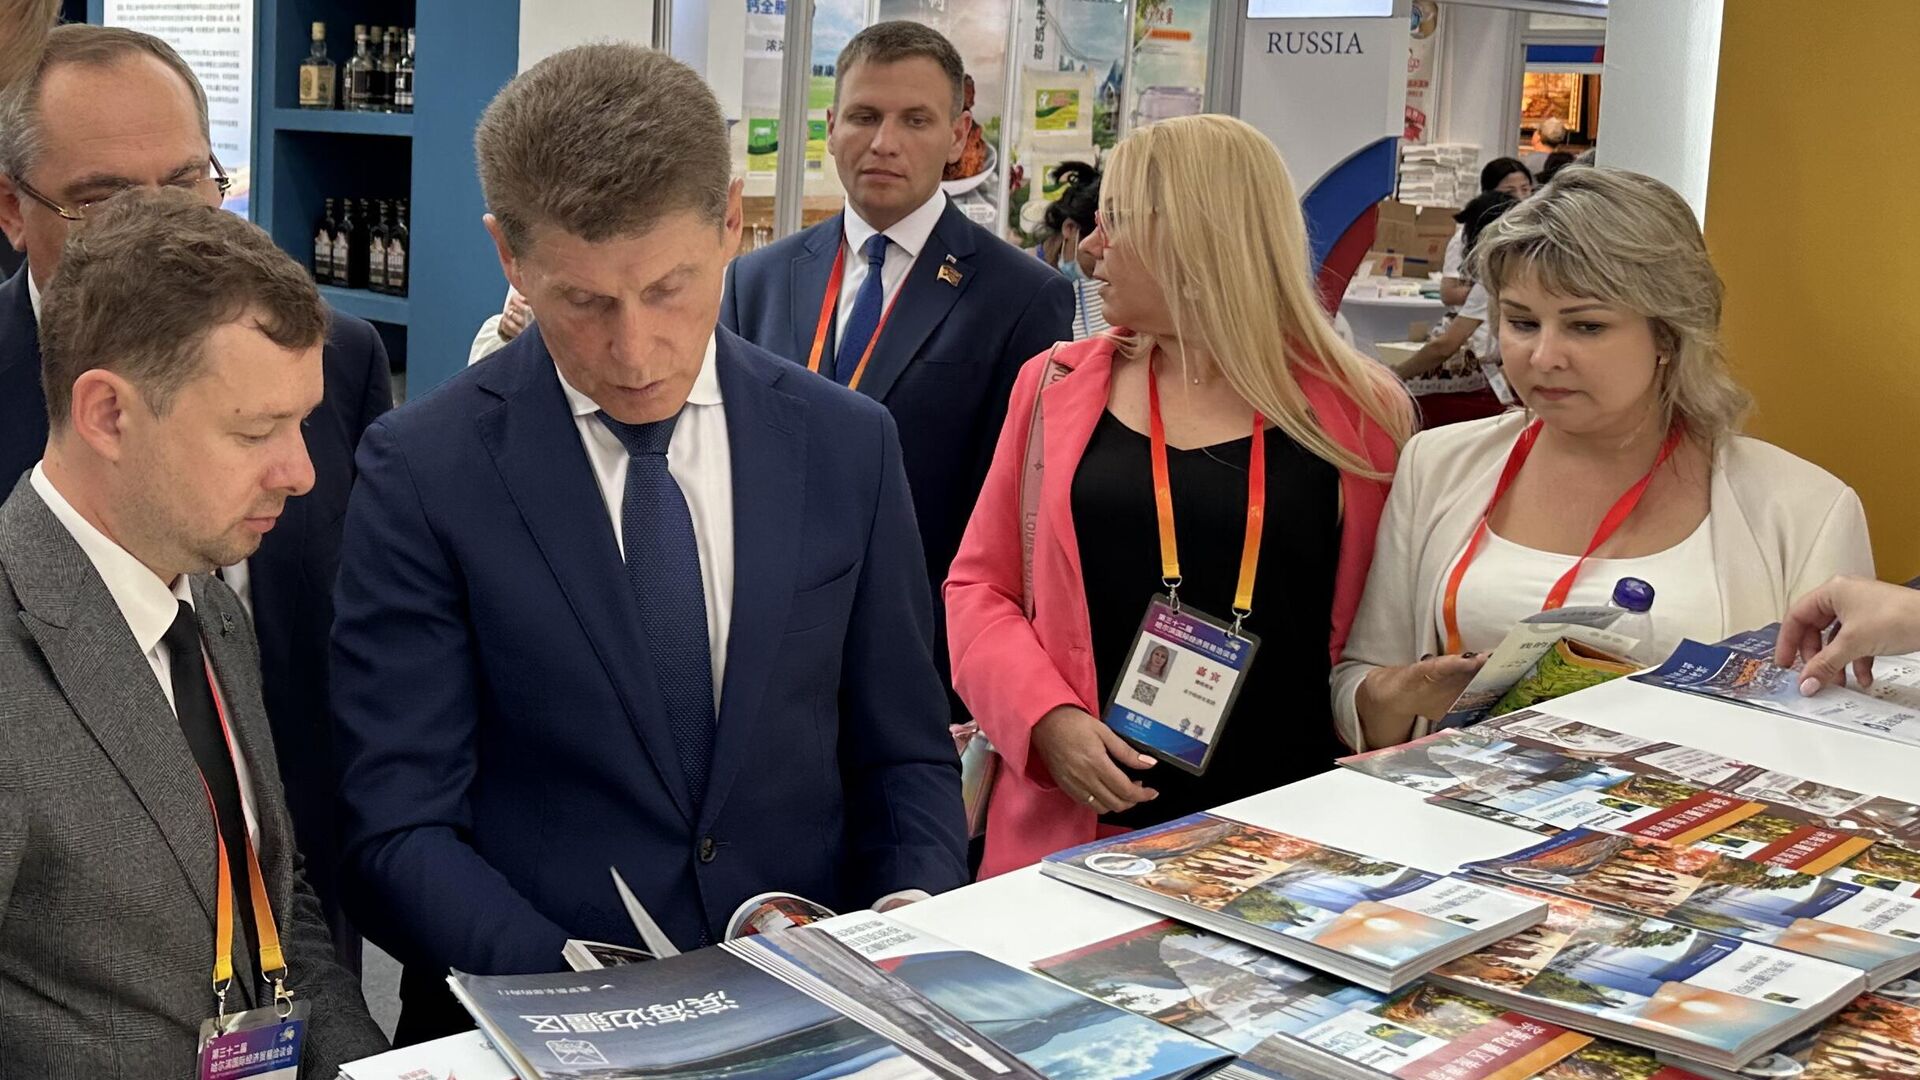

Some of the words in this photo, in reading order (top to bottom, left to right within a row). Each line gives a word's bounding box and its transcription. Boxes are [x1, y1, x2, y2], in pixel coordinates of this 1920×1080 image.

[1266, 31, 1364, 54] RUSSIA
[518, 990, 740, 1033] 滨海边疆区
[212, 1042, 248, 1060] 第三十二届
